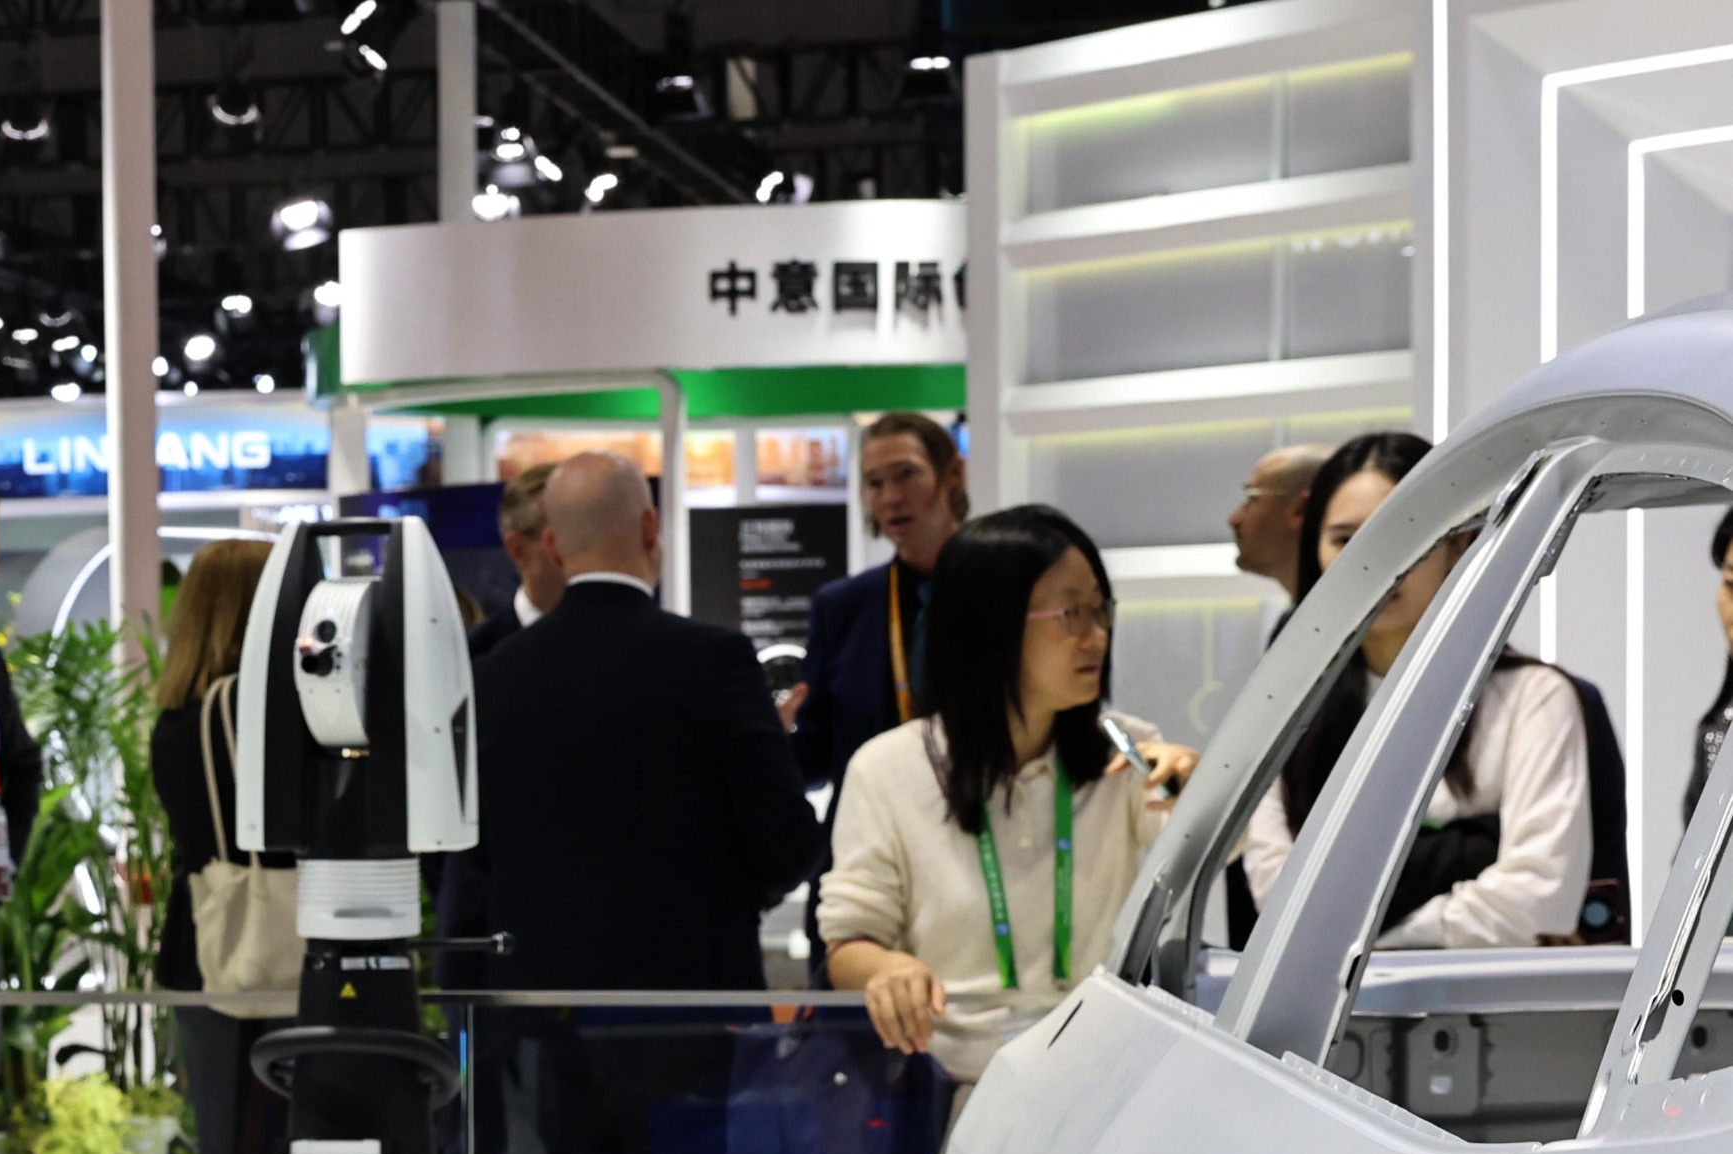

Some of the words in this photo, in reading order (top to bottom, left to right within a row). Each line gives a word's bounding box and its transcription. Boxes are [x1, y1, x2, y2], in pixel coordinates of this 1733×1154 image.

[708, 258, 966, 316] 中意国际
[22, 430, 272, 475] LINANG
